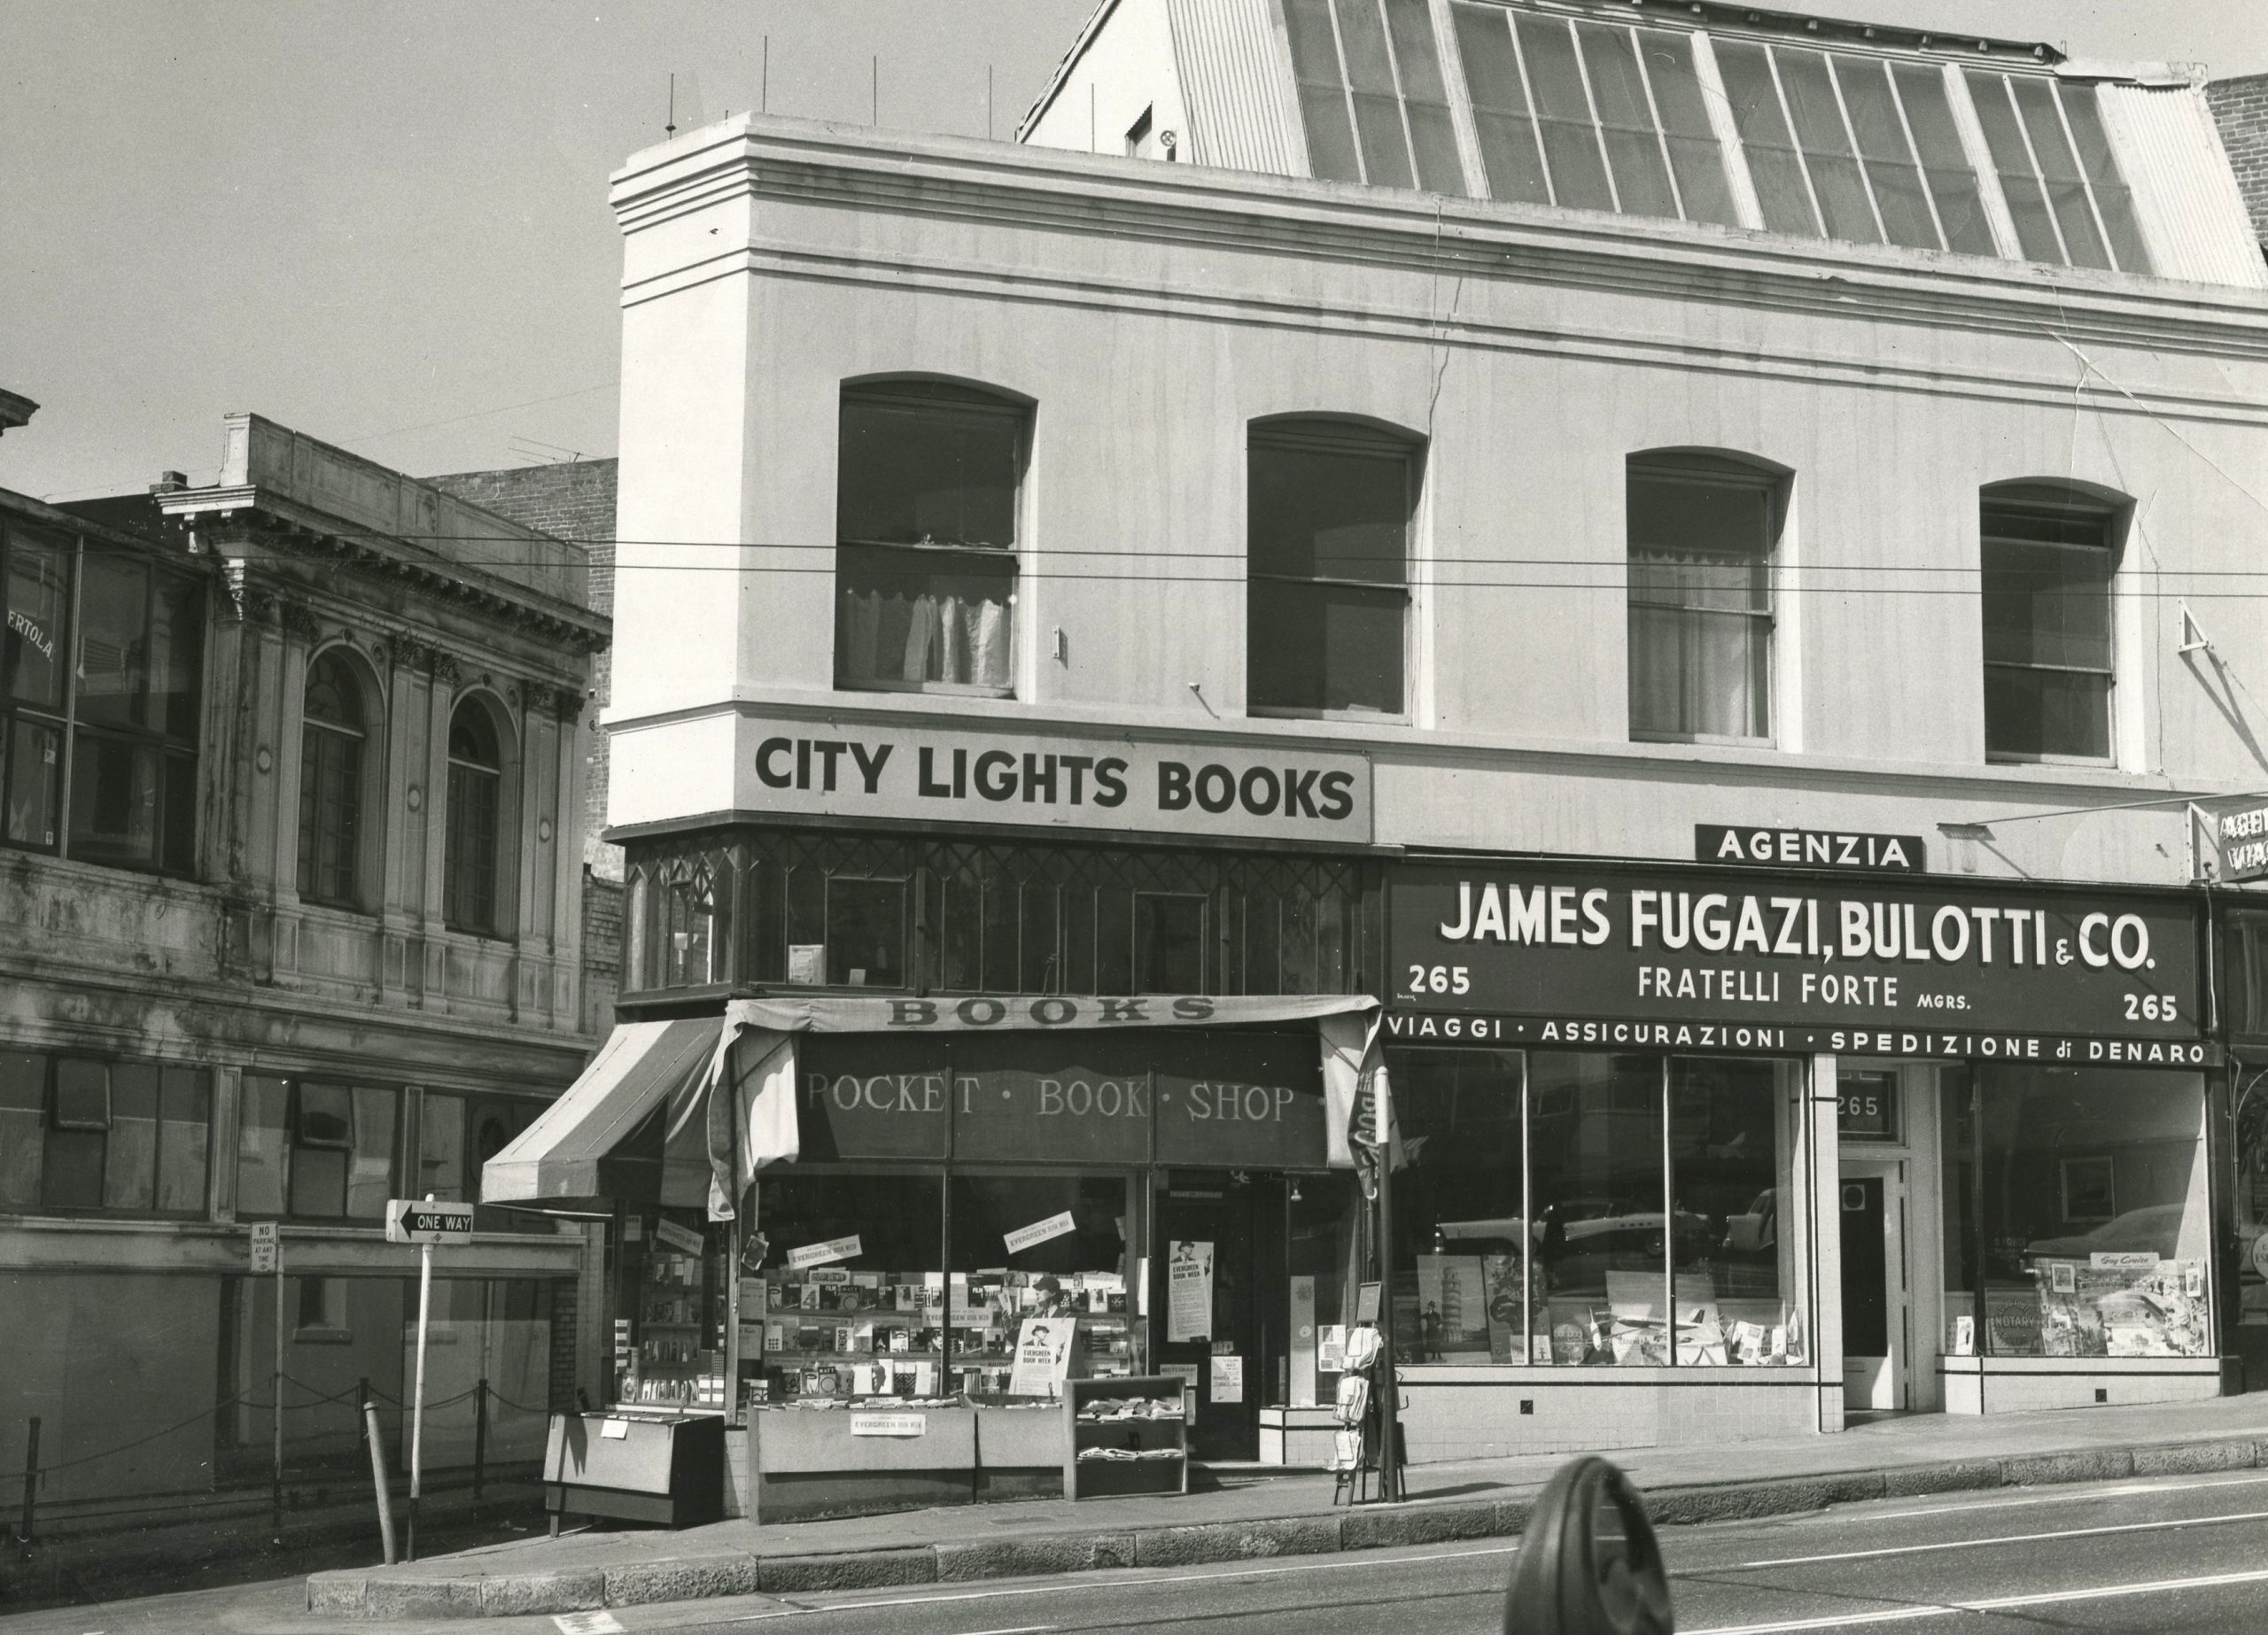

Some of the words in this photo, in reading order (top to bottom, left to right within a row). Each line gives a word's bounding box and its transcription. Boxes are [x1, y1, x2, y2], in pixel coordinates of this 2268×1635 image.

[756, 738, 894, 794] CITY
[919, 746, 1128, 807] LIGHTS
[1158, 761, 1355, 820] BOOKS
[1717, 830, 1910, 866] AGENZIA
[1441, 881, 1610, 945] JAMES
[1632, 889, 1834, 965] FUGAZI,
[1841, 900, 2046, 965] BULOTTI
[2055, 939, 2074, 965] &
[2078, 912, 2155, 969] CO.
[1410, 965, 1470, 995] 265
[1639, 966, 1778, 1003] FRATELLI
[1802, 973, 1898, 1007] FORTE
[1917, 994, 1971, 1010] MGRS.
[889, 997, 1216, 1026] BOOKS
[2124, 994, 2177, 1021] 265
[1388, 1016, 1501, 1039] VIAGGI
[1542, 1021, 1784, 1048] ASSICURAZIONI
[1831, 1031, 2039, 1058] SPEDIZIONE
[2056, 1040, 2072, 1058] di
[2089, 1042, 2204, 1062] DENARO
[807, 1073, 981, 1113] POCKET
[1037, 1078, 1149, 1117] BOOK
[1186, 1081, 1294, 1122] SHOP
[1837, 1096, 1877, 1115] 265
[259, 1226, 270, 1236] NO
[417, 1214, 440, 1229] ONE
[445, 1215, 470, 1231] WAY
[1173, 1264, 1199, 1273] EVERGREEN
[1994, 1316, 2035, 1327] NOTARY
